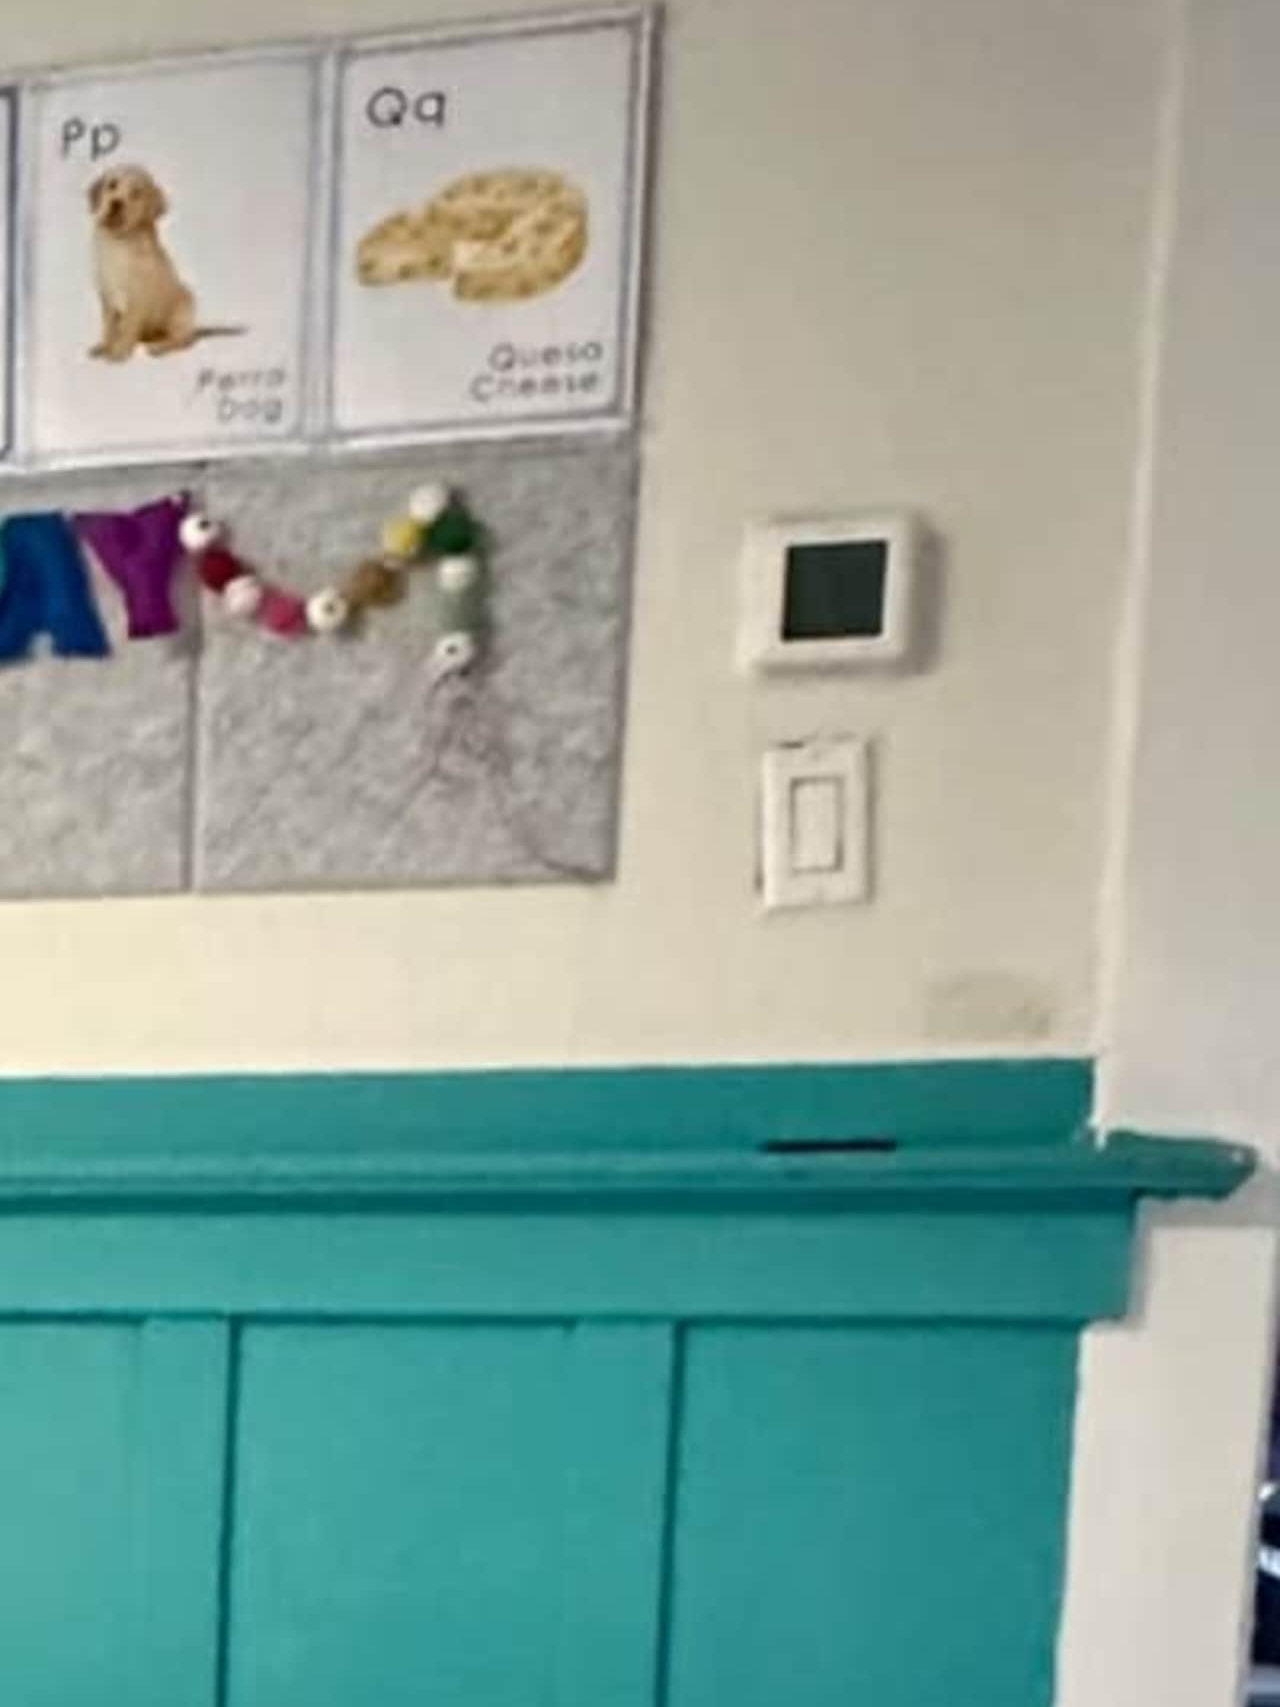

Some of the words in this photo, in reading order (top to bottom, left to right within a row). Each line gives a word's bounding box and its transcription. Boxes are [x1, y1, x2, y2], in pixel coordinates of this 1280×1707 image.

[366, 86, 446, 129] Qq
[60, 116, 122, 161] Pp
[488, 340, 604, 372] Queso
[196, 367, 287, 395] Perro
[469, 372, 599, 402] Cheese
[216, 396, 283, 424] Dog
